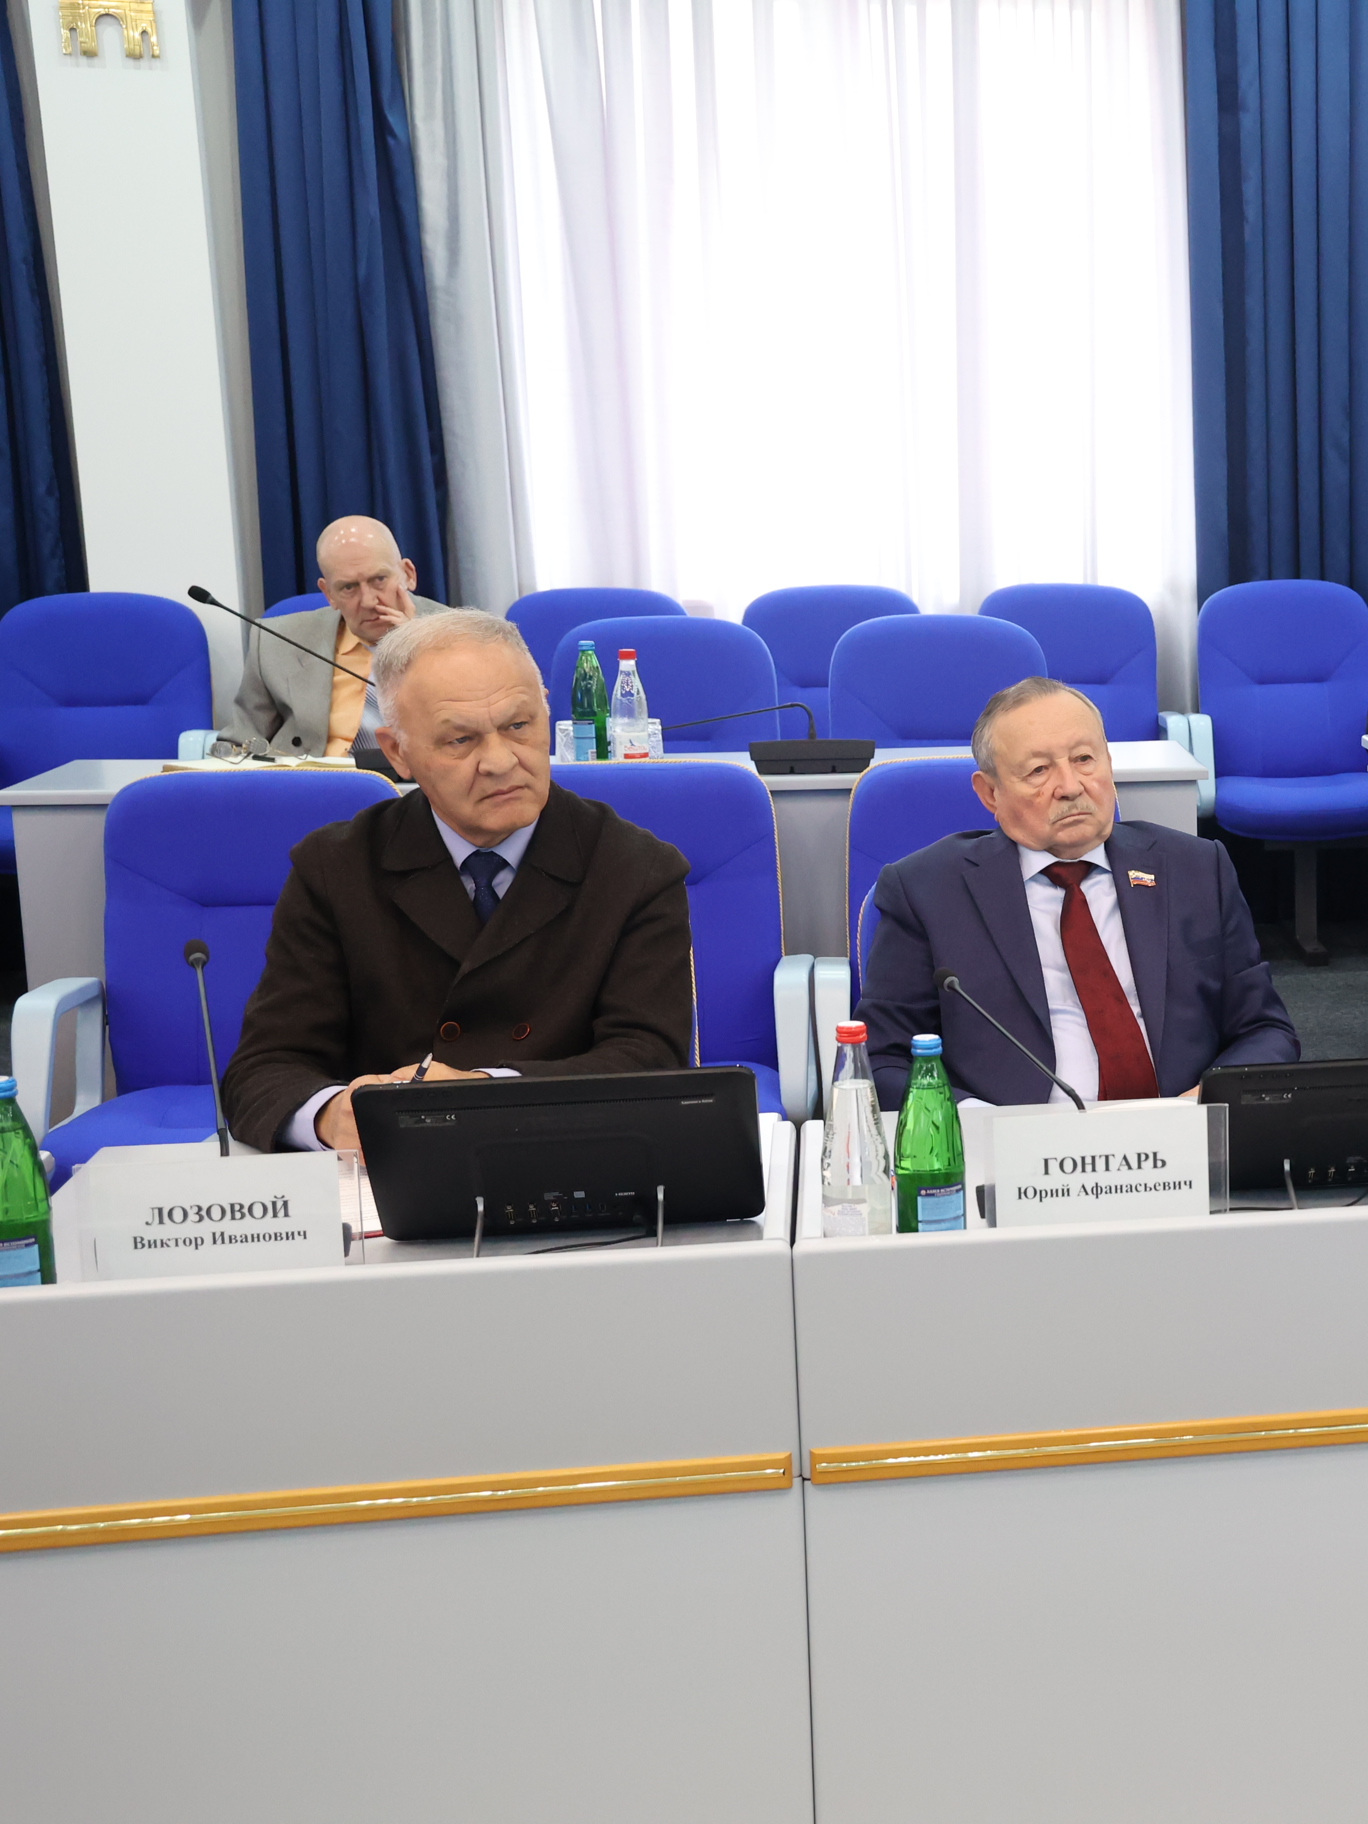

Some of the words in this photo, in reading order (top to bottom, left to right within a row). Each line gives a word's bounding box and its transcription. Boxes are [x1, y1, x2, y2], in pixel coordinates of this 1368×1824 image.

[1042, 1151, 1168, 1176] ГОНТАРЬ
[1017, 1184, 1072, 1202] Юрий
[1077, 1180, 1193, 1200] Афанасьевич
[145, 1195, 291, 1226] ЛОЗОВОЙ
[132, 1235, 205, 1251] Виктор
[210, 1229, 308, 1246] Иванович
